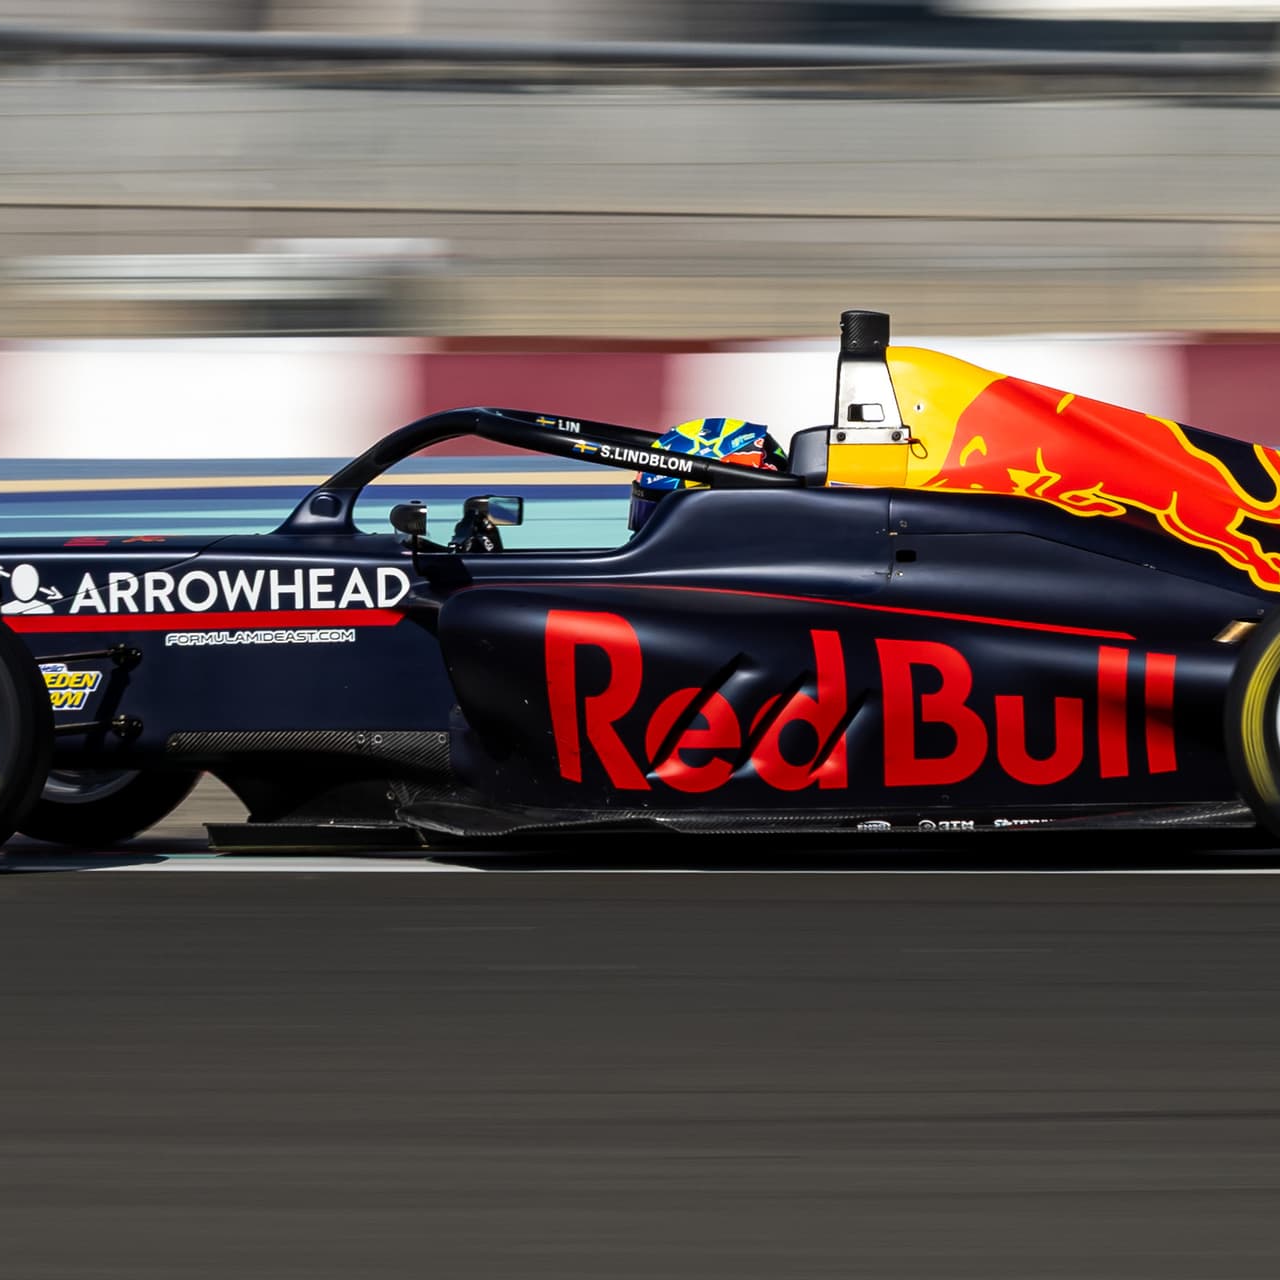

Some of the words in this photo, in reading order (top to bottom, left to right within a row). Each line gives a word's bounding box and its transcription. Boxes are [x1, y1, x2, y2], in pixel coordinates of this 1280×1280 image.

[600, 444, 693, 473] S.LINDBLOM
[69, 567, 411, 613] ARROWHEAD
[166, 629, 355, 646] FORMULAMIDEAST.COM
[43, 672, 98, 688] EDEN
[544, 609, 848, 793] Red
[875, 638, 1177, 788] Bull
